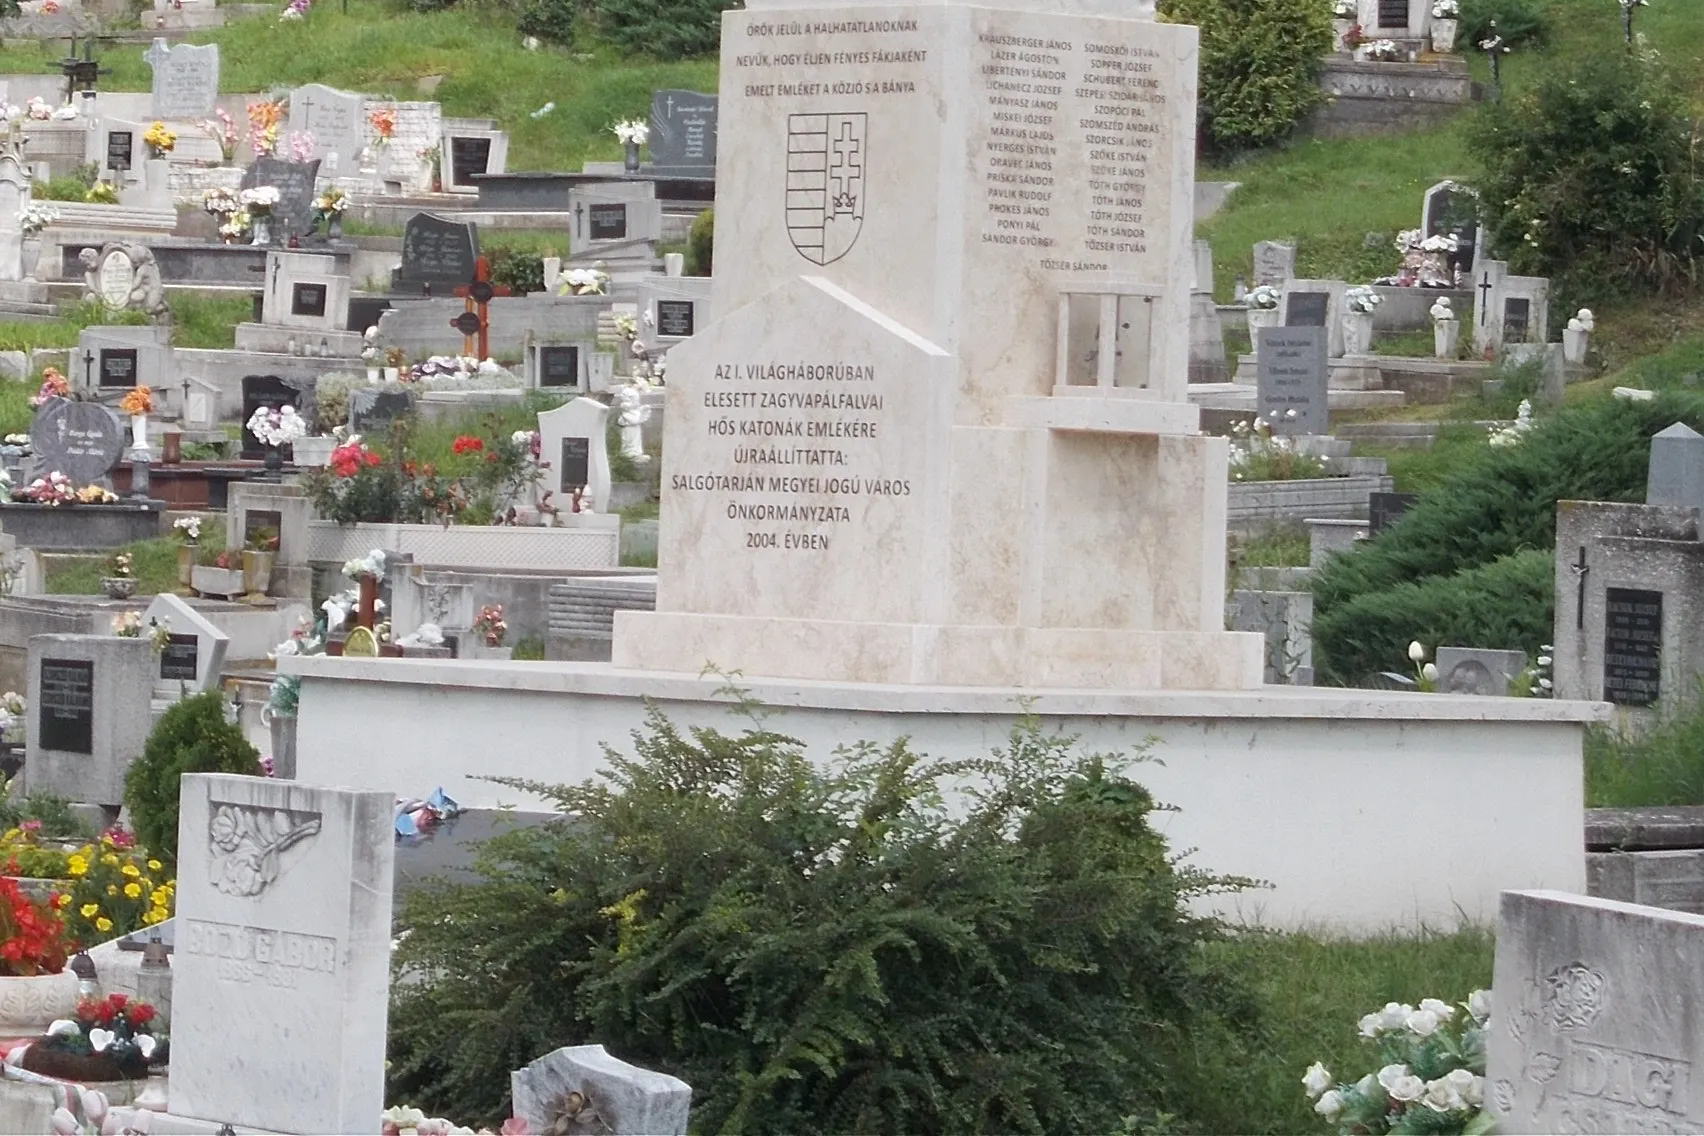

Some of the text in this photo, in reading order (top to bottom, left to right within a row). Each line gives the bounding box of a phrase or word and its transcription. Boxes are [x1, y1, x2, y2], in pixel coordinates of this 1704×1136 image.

[747, 21, 775, 37] ÖRÖK
[804, 22, 812, 35] A
[814, 19, 918, 35] HALHATATLANOKNAK
[1045, 38, 1073, 51] JÁNOS
[773, 53, 801, 67] HOGY
[803, 50, 831, 66] ÉLJEN
[833, 50, 869, 65] FÉNYES
[1031, 67, 1067, 81] SÁNDOR
[745, 82, 774, 97] EMELT
[777, 80, 820, 97] EMLÉKET
[822, 83, 830, 95] A
[872, 82, 880, 94] A
[882, 79, 915, 94] BÁNYA
[1128, 77, 1160, 89] FERENC
[1031, 97, 1058, 111] JÁNOS
[987, 142, 1025, 153] NYERGES
[1118, 151, 1147, 162] ISTVÁN
[1018, 190, 1052, 201] RUDOLF
[997, 219, 1041, 232] PONYI PÁL
[715, 363, 874, 381] AZ I. VILÁGHÁBORÚBAN
[704, 391, 884, 410] ELESETT ZAGYVAPÁLFALVAI
[708, 416, 877, 438] HŐS KATONÁK EMLÉKÉRE
[734, 446, 849, 466] ÚJRAÁLLÍTTATTA:
[672, 473, 911, 496] SALGÓTARJÁN MEGYEI JOGÚ VÁROS
[727, 499, 850, 523] ÖNKORMÁNYZATA
[746, 530, 828, 550] 2004. ÉVBEN
